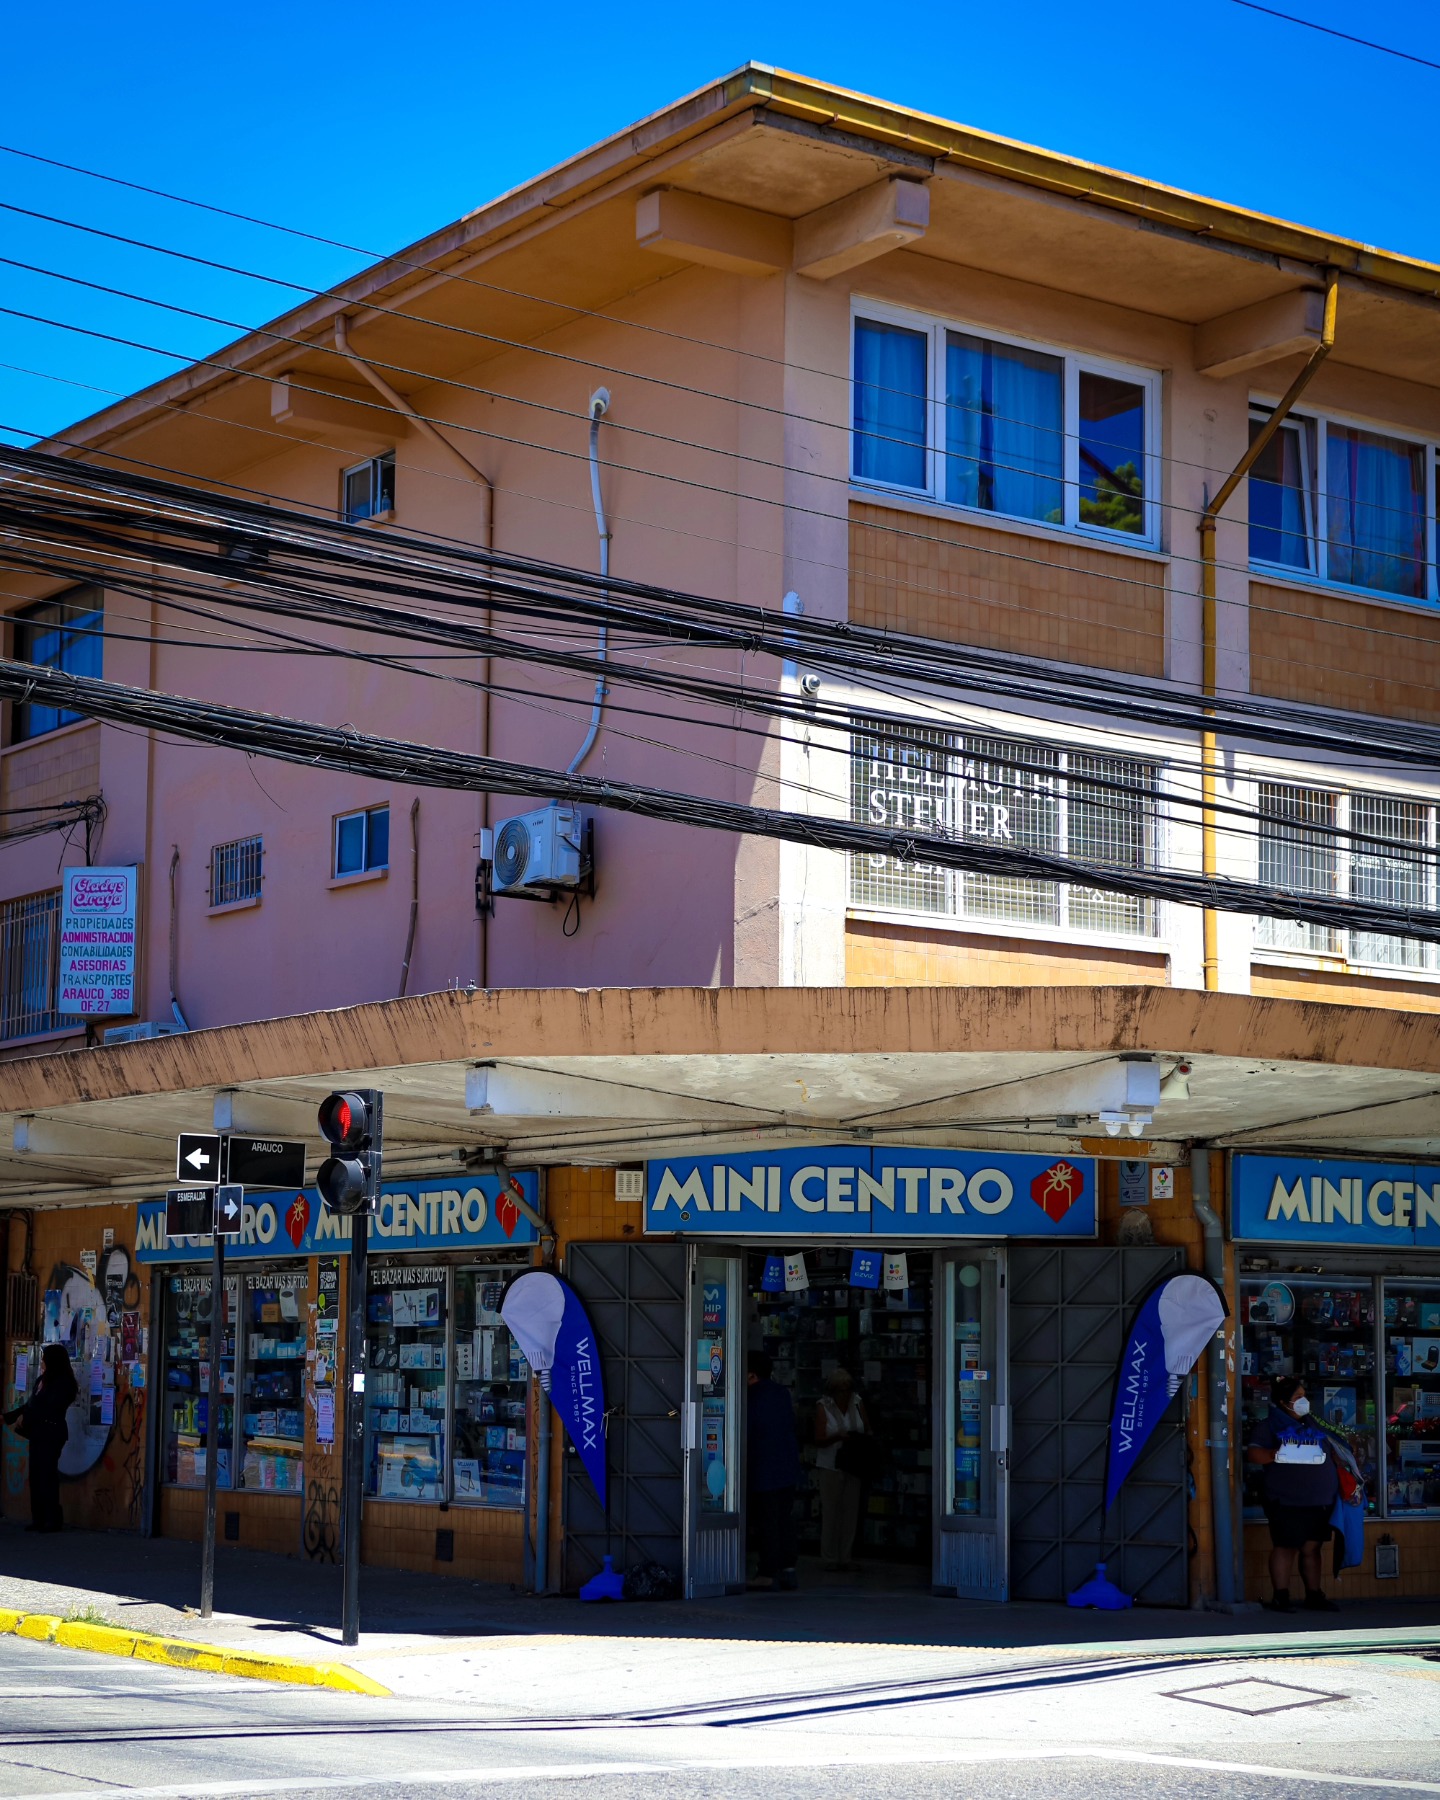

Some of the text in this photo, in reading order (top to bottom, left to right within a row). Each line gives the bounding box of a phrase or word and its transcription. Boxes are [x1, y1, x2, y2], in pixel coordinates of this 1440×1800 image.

[75, 878, 124, 894] Gladys
[65, 917, 134, 929] PROPIEDADES
[61, 931, 134, 943] ADMINISTRACION
[61, 945, 133, 957] CONTABILIDADES
[69, 959, 127, 971] ASESORIAS
[62, 973, 132, 986] TRANSPORTES
[62, 987, 130, 1000] ARAUCO 389
[251, 1141, 284, 1154] ARAUCO
[177, 1191, 207, 1202] ESMERALDA
[651, 1165, 1014, 1215] MINI CENTRO
[1266, 1174, 1363, 1225] MINI
[375, 1187, 488, 1237] CENTRO
[255, 1275, 274, 1290] BAZAR
[274, 1274, 286, 1290] MAS
[286, 1274, 309, 1289] SURTIDO
[381, 1268, 402, 1285] BAZAR
[402, 1267, 416, 1284] MAS
[416, 1266, 446, 1284] SURTIDO"
[183, 1278, 201, 1292] BAZAR
[201, 1277, 212, 1291] MAS
[570, 1365, 581, 1424] SINCE 1987
[575, 1336, 597, 1450] WELLMAX
[1118, 1339, 1148, 1453] WELLMAX
[1136, 1369, 1150, 1428] SINCE 1987
